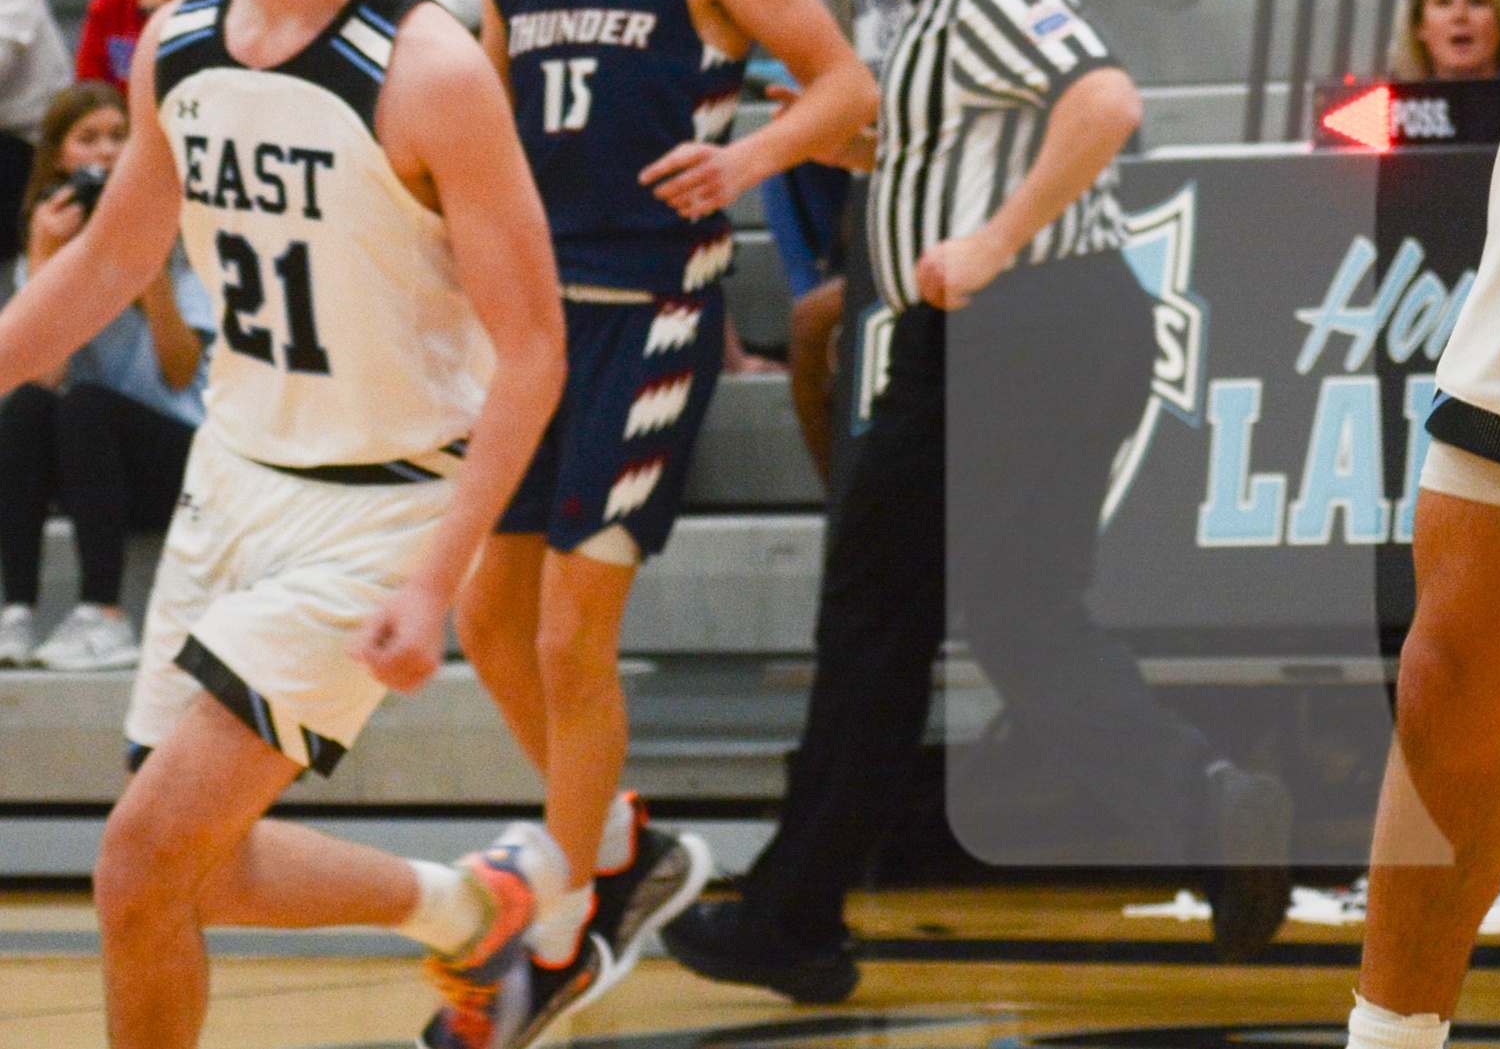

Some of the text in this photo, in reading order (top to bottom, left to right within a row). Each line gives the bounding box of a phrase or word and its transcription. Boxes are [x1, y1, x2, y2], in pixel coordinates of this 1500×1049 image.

[508, 7, 657, 58] THUNDER
[540, 57, 599, 133] 15
[184, 134, 334, 221] EAST
[216, 229, 332, 377] 21
